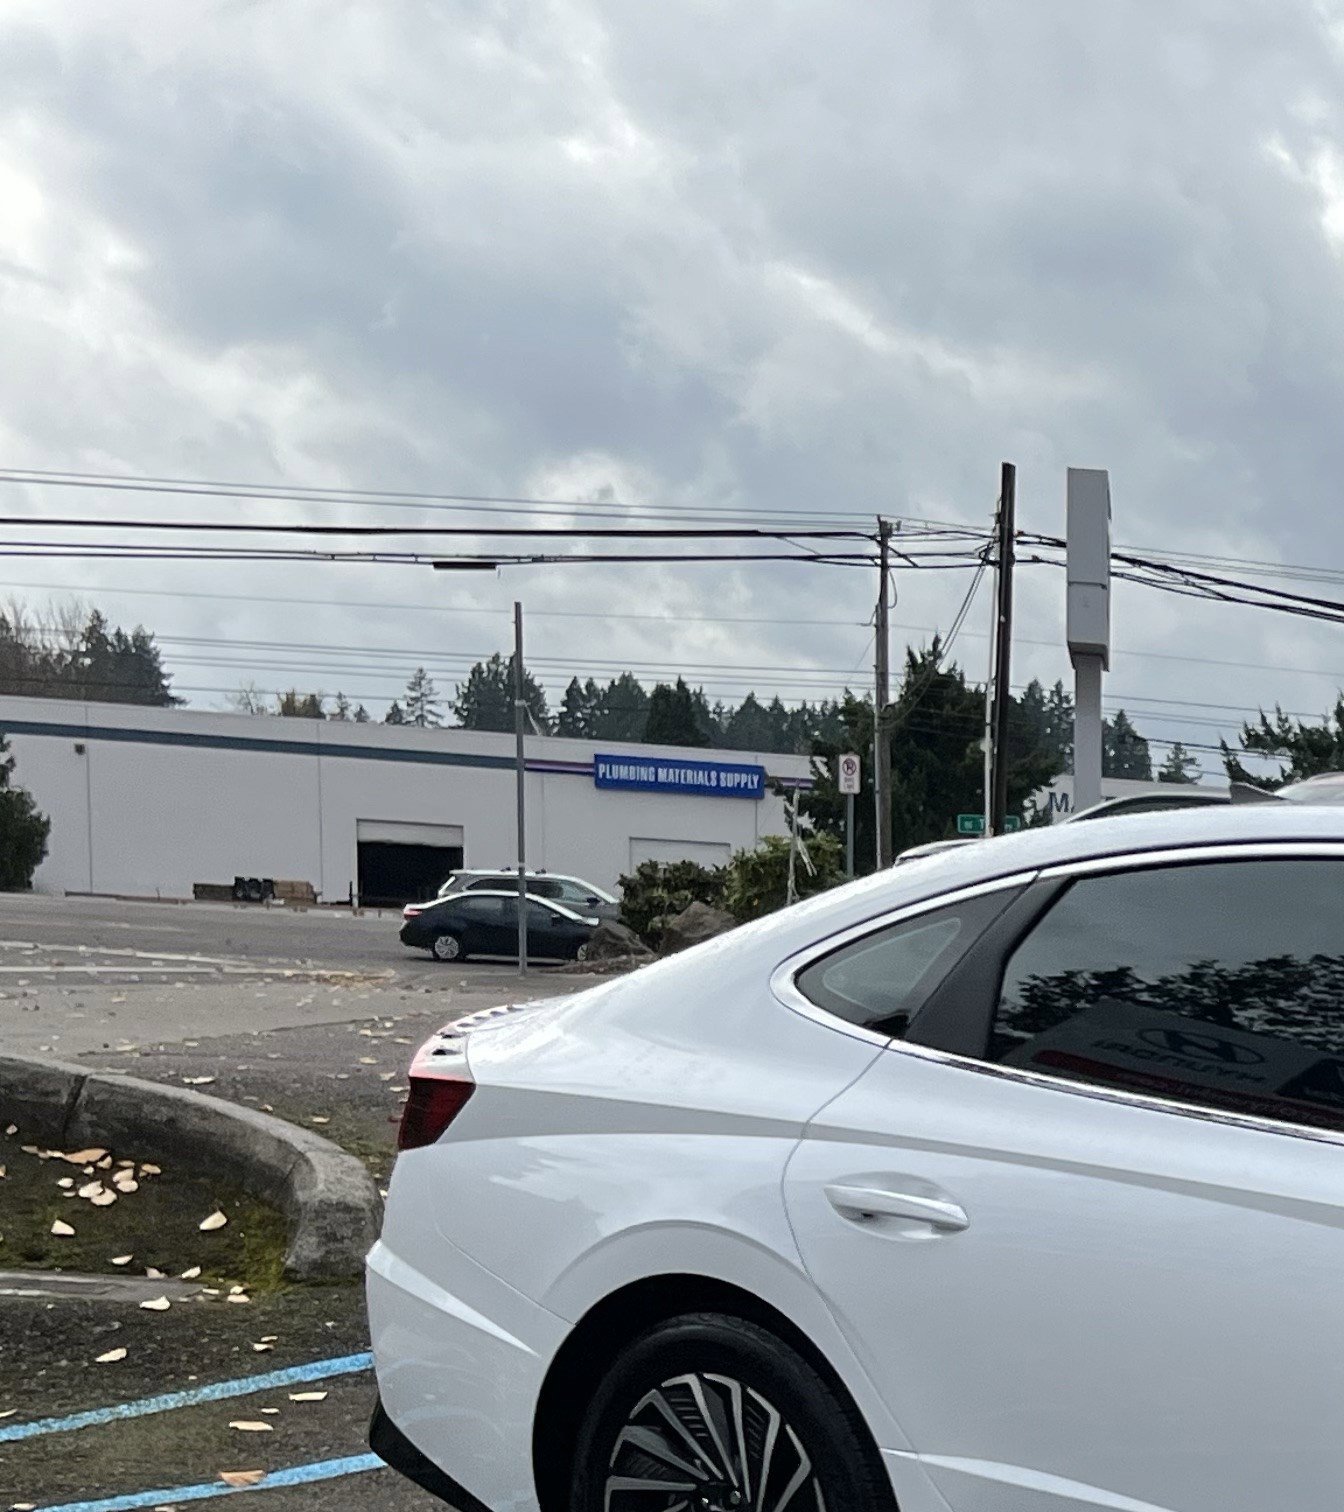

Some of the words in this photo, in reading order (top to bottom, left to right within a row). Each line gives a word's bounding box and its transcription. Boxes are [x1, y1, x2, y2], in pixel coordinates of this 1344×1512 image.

[598, 763, 656, 782] PLUMBING
[657, 767, 717, 787] MATERIALS
[719, 772, 759, 790] SUPPLY
